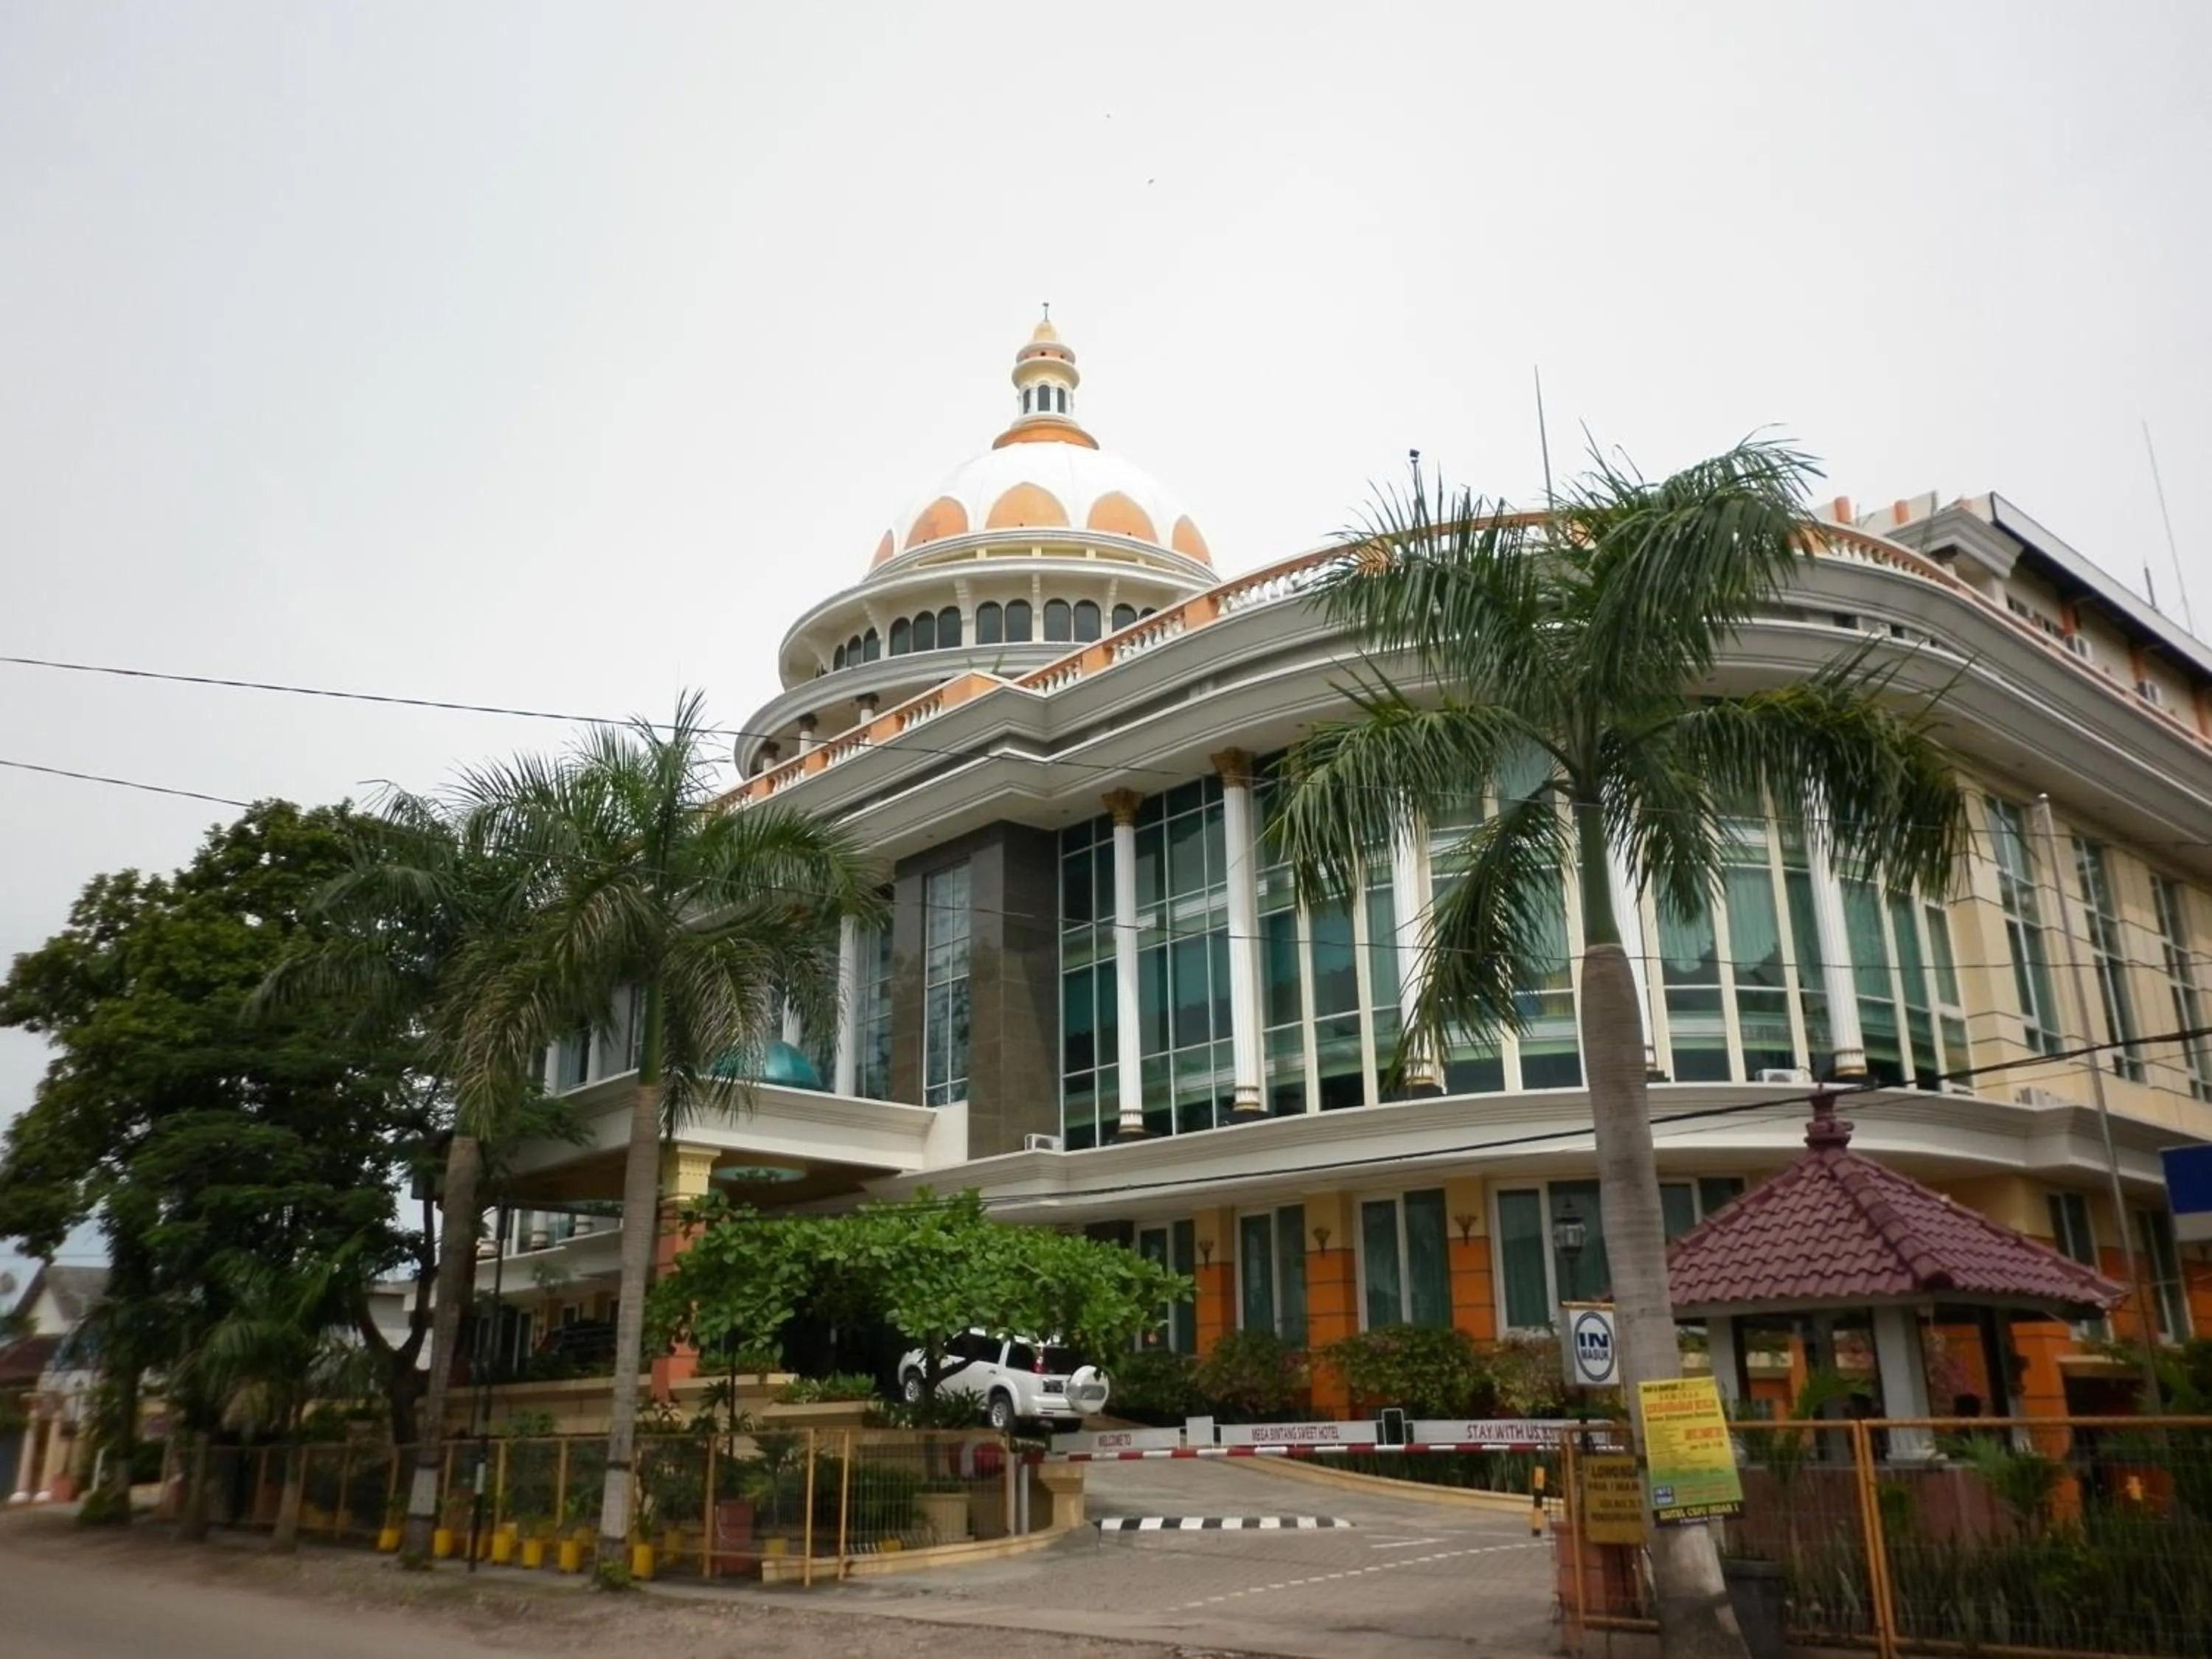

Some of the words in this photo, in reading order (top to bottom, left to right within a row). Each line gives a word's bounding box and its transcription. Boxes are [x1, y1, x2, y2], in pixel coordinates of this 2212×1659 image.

[1579, 1332, 1608, 1348] IN
[1251, 1427, 1269, 1441] MEGA
[1270, 1427, 1297, 1440] BINTANG
[1297, 1426, 1317, 1439] SWEET
[1318, 1425, 1340, 1439] HOTEL
[1467, 1425, 1492, 1439] STAY
[1493, 1425, 1525, 1439] WITH
[1098, 1434, 1123, 1447] WELCOME
[1124, 1433, 1132, 1445] TO
